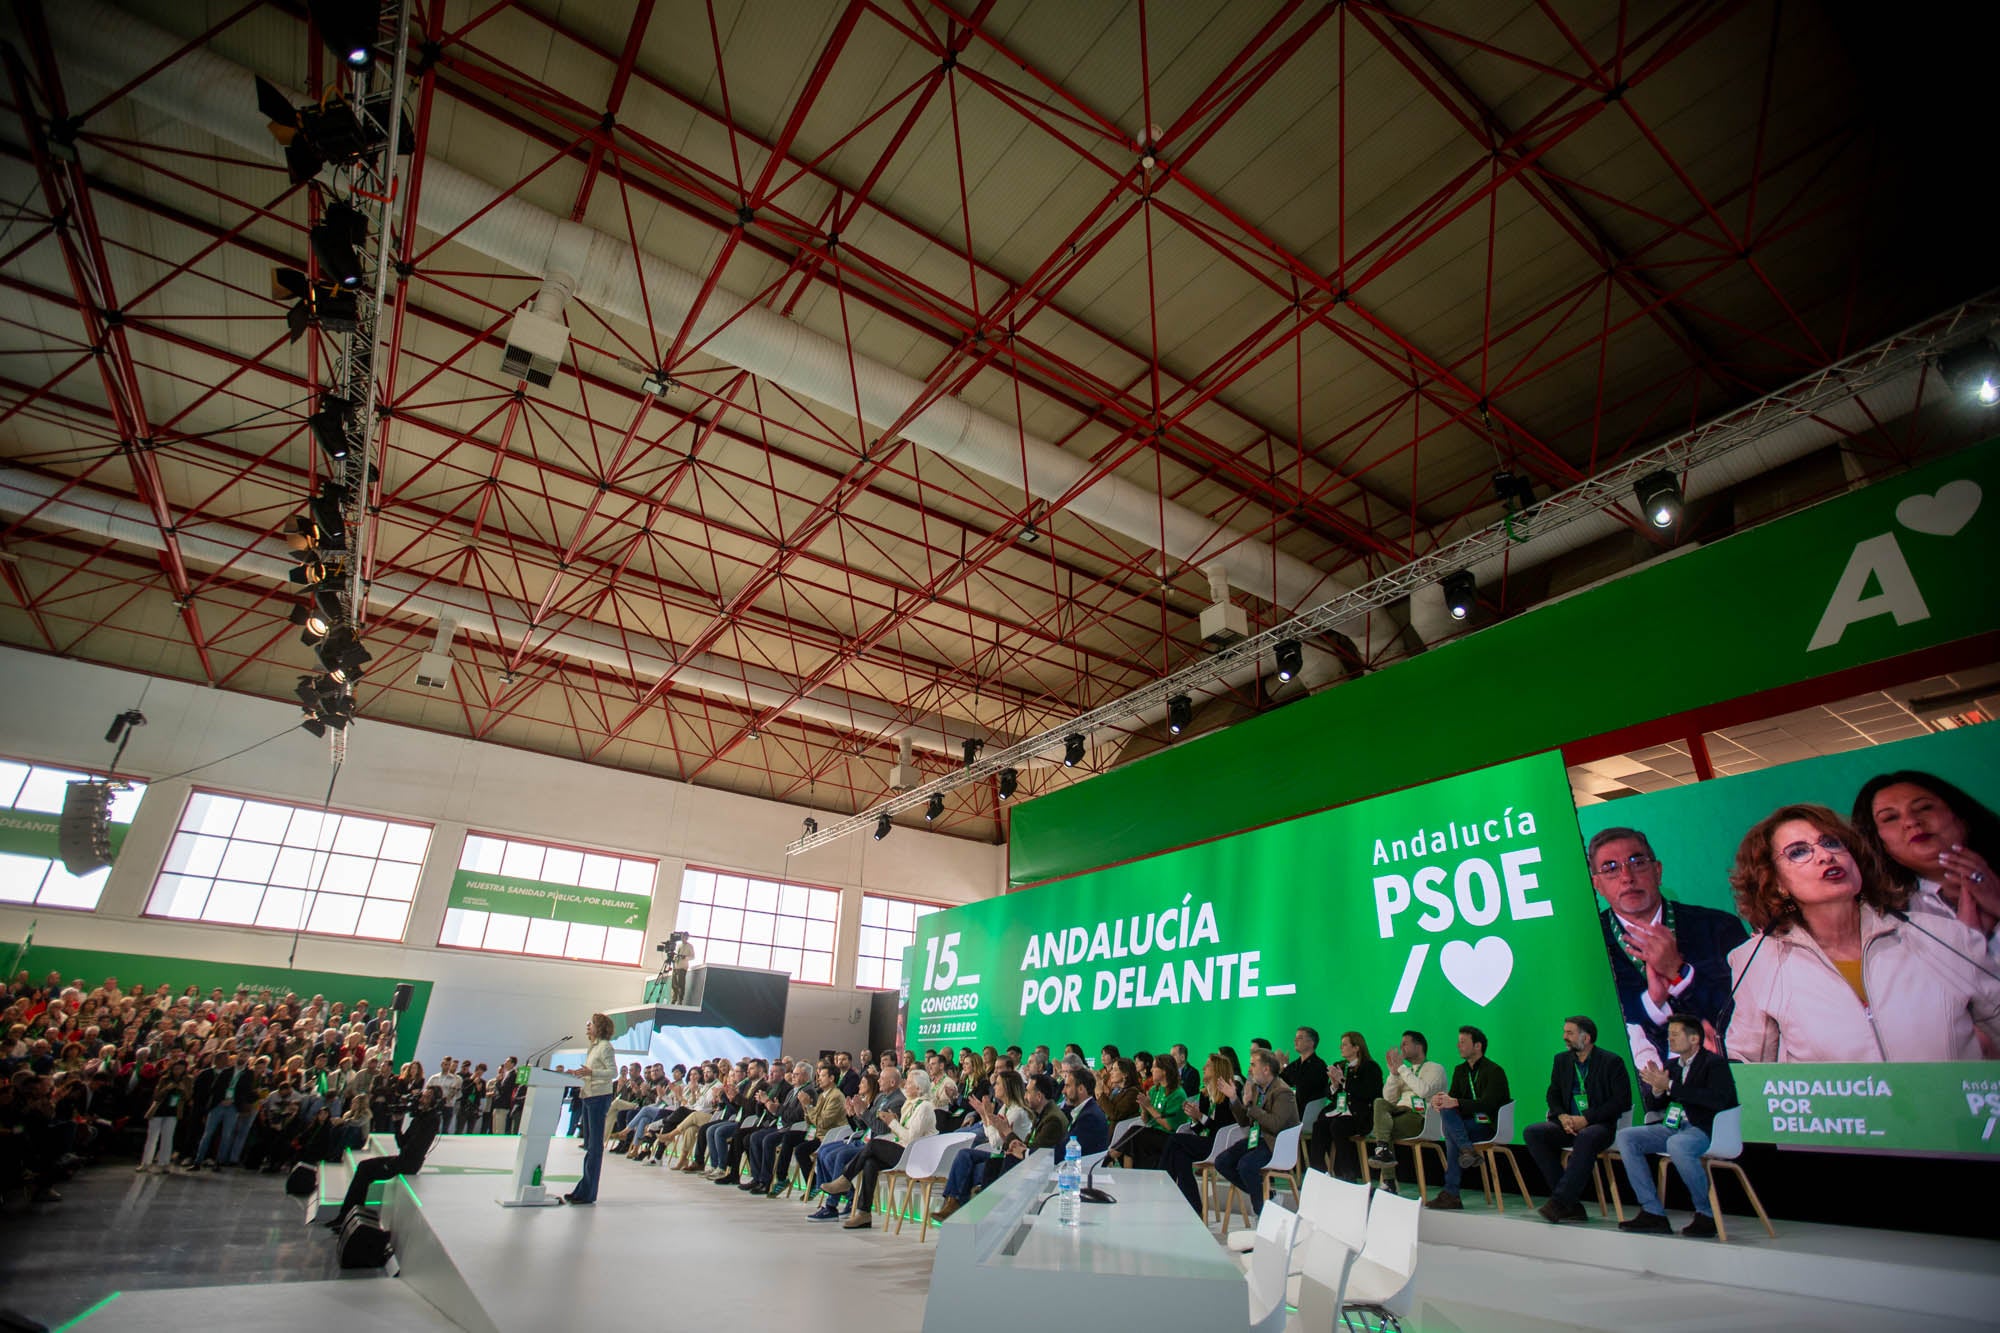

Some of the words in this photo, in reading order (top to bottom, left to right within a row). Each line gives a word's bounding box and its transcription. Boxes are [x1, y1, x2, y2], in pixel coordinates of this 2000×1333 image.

[1373, 807, 1537, 865] Andalucía
[466, 880, 505, 892] NUESTRA
[507, 886, 546, 898] SANIDAD
[583, 896, 600, 904] POR
[1373, 847, 1554, 938] PSOE
[1020, 892, 1220, 971] ANDALUCÍA
[921, 992, 979, 1014] CONGRESO
[1019, 974, 1083, 1016] POR
[919, 1023, 941, 1035] 22/23
[943, 1021, 977, 1033] FEBRERO
[1763, 1076, 1893, 1097] ANDALUCÍA
[1768, 1098, 1812, 1115] POR
